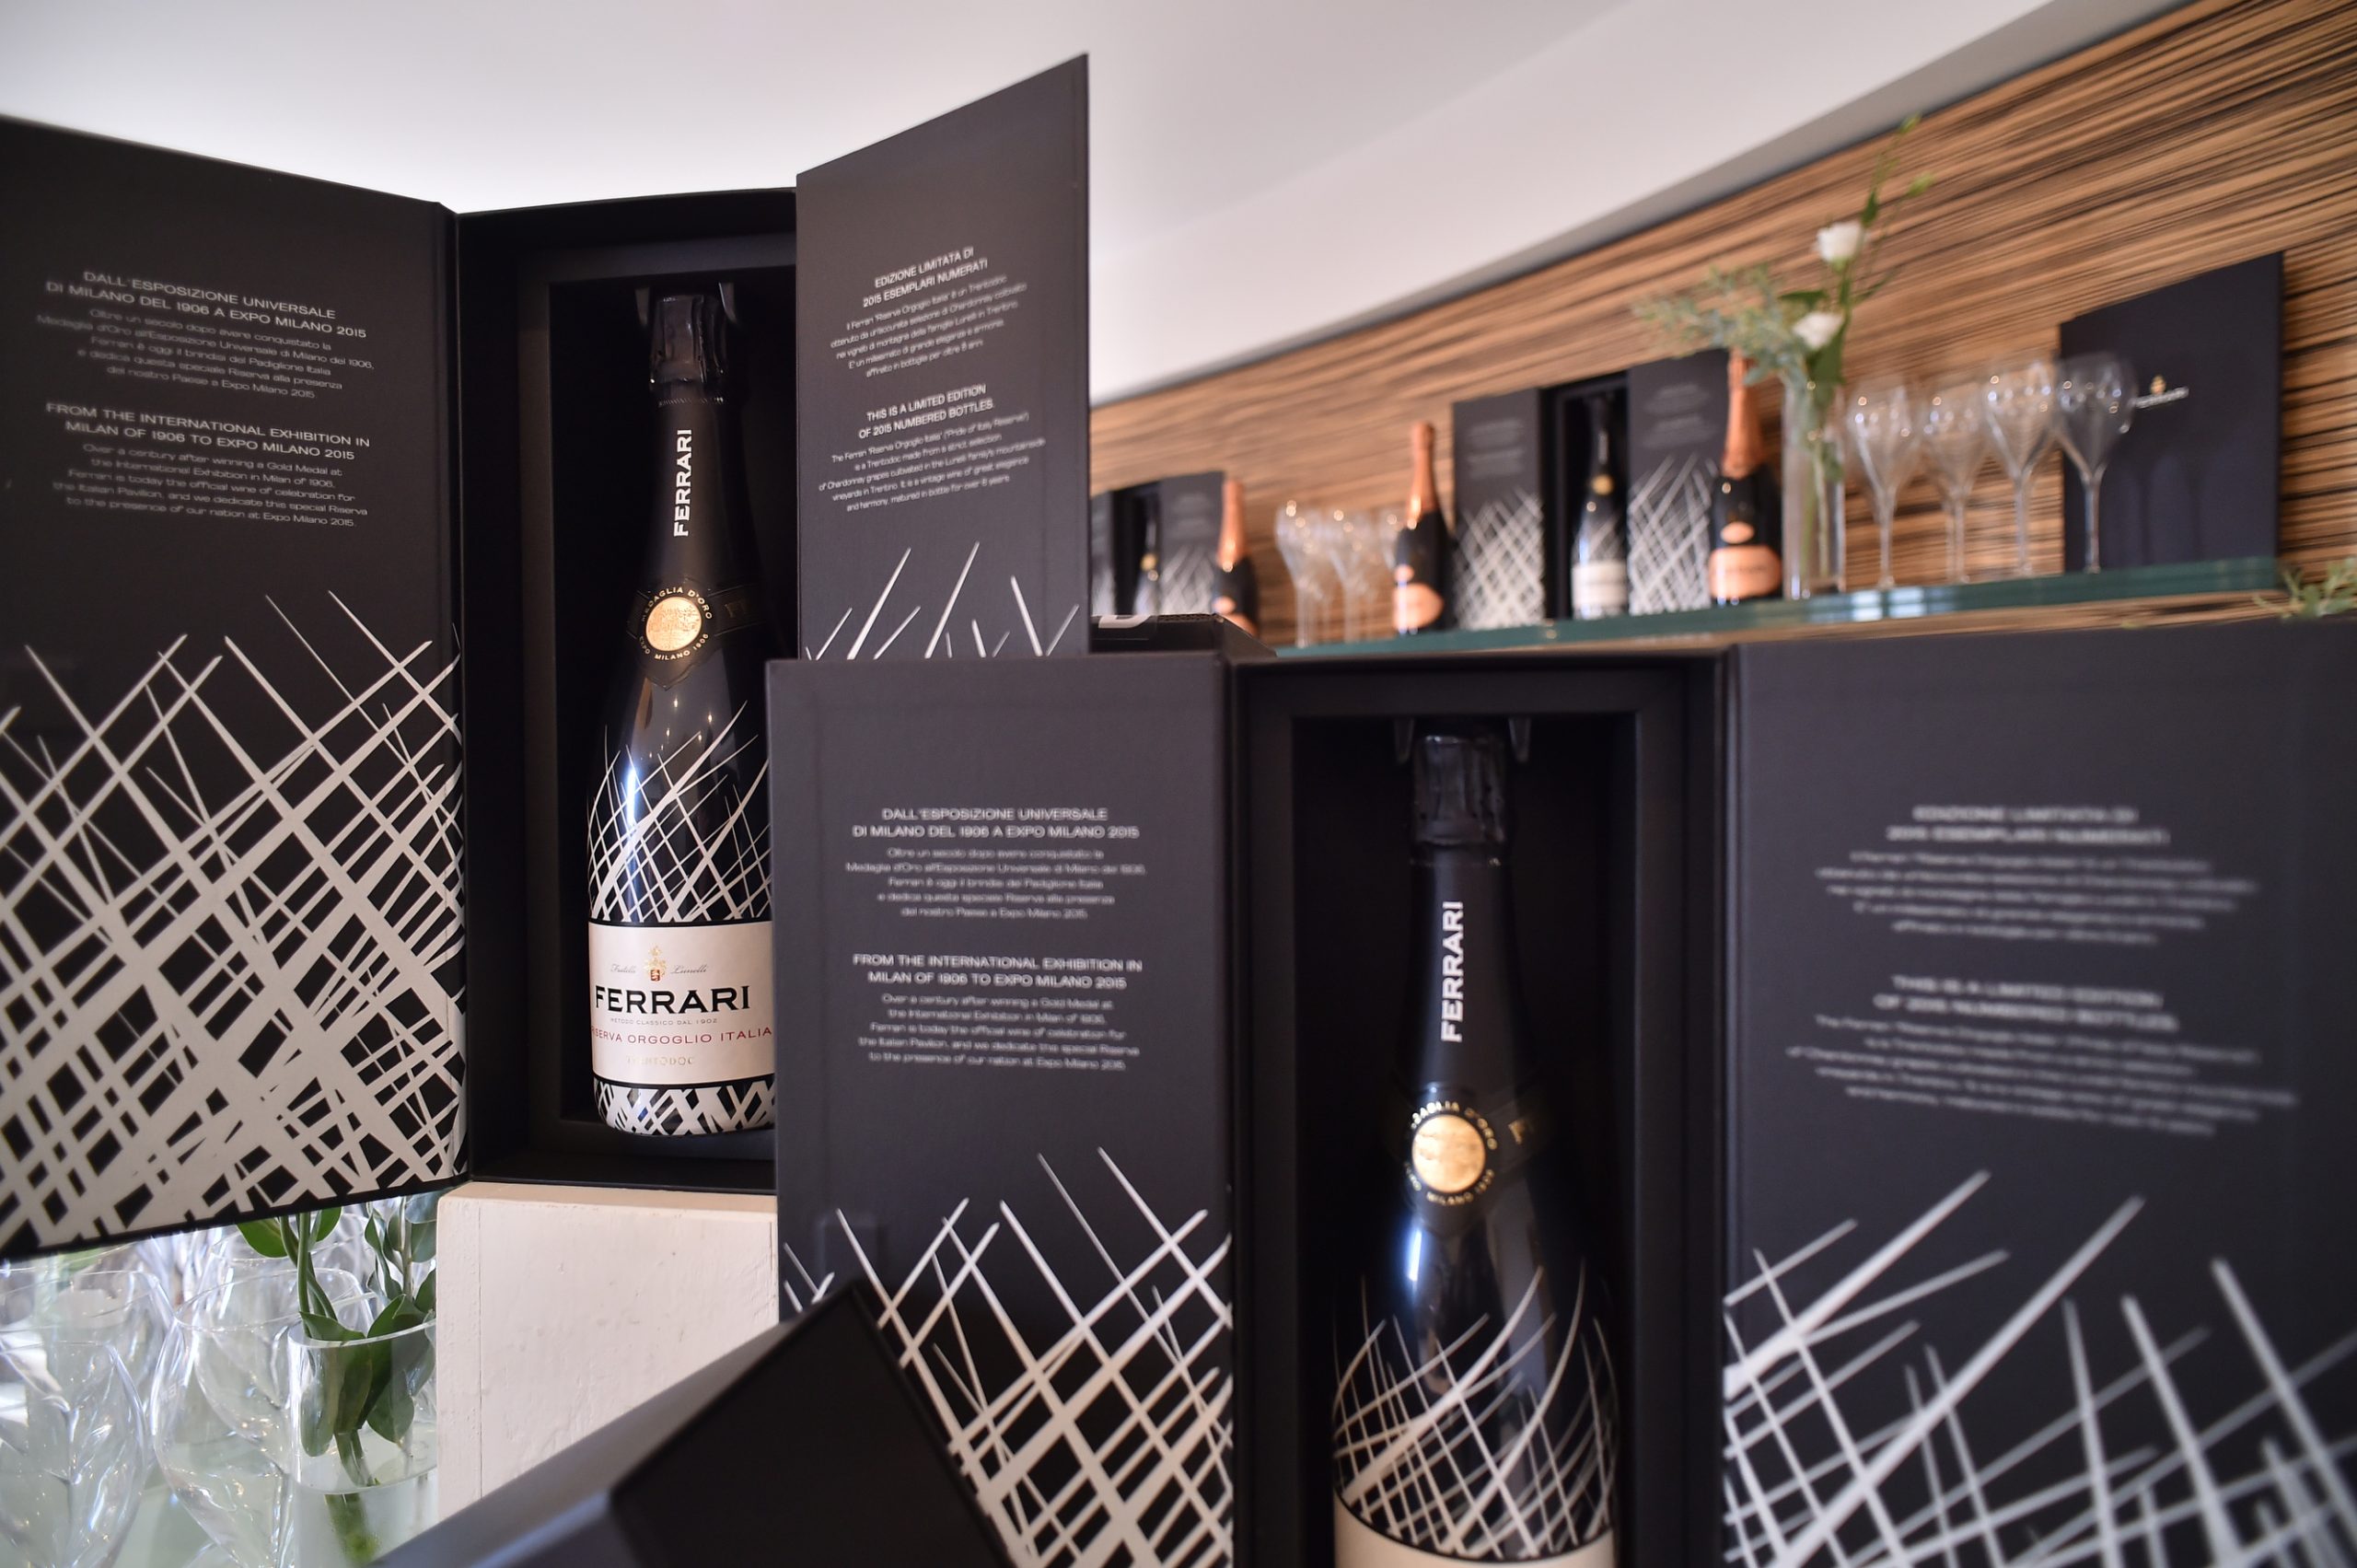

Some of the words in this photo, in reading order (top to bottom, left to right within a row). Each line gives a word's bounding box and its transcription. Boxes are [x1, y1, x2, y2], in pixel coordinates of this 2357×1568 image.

[875, 266, 916, 287] EDIZIONE
[918, 251, 961, 273] LIMITATA
[962, 247, 973, 259] DI
[863, 294, 881, 307] 2015
[883, 276, 935, 300] ESEMPLARI
[936, 259, 987, 283] NUMERATI
[84, 272, 238, 303] DALL'ESPOSIZIONE
[243, 297, 335, 319] UNIVERSALE
[45, 281, 63, 293] DI
[68, 285, 134, 303] MILANO
[139, 296, 170, 308] DEL
[177, 302, 209, 314] 1906
[214, 308, 225, 317] A
[229, 309, 271, 323] EXPO
[274, 317, 331, 332] MILANO
[336, 326, 366, 337] 2015
[219, 329, 251, 339] avere
[253, 334, 319, 348] conquistato
[219, 341, 277, 355] Universale
[293, 351, 327, 362] Milano
[348, 359, 374, 368] 1906,
[228, 367, 270, 379] Riserva
[293, 377, 342, 389] presenza
[306, 366, 331, 375] Italia
[221, 379, 250, 389] Expo
[251, 383, 287, 394] Milano
[866, 408, 887, 421] THIS
[888, 405, 898, 416] IS
[900, 403, 906, 413] A
[908, 394, 945, 412] LIMITED
[946, 384, 986, 401] EDITION
[46, 402, 97, 416] FROM
[102, 409, 134, 422] THE
[140, 414, 265, 436] INTERNATIONAL
[270, 428, 351, 444] EXHIBITION
[355, 437, 369, 447] IN
[858, 427, 871, 438] OF
[873, 423, 891, 436] 2015
[893, 410, 946, 429] NUMBERED
[65, 421, 119, 435] MILAN
[123, 427, 146, 437] OF
[152, 431, 185, 442] 1906
[190, 434, 212, 445] TO
[216, 437, 258, 449] EXPO
[262, 442, 319, 456] MILANO
[325, 449, 354, 459] 2015
[206, 458, 254, 469] winning
[266, 462, 293, 470] Gold
[296, 464, 328, 474] Medal
[262, 474, 291, 482] Milan
[308, 479, 334, 487] 1906.
[674, 429, 691, 537] FERRARI
[274, 490, 335, 499] celebration
[213, 496, 262, 506] dedicate
[265, 500, 286, 508] this
[328, 505, 367, 515] Riserva
[262, 512, 290, 521] Expo
[293, 515, 328, 524] Milano
[688, 589, 712, 620] D'ORO
[655, 650, 691, 660] MILANO
[1017, 808, 1107, 820] UNIVERSALE
[853, 825, 867, 837] DI
[870, 826, 924, 837] MILANO
[927, 826, 956, 837] DEL
[992, 826, 1003, 836] A
[1005, 826, 1045, 838] EXPO
[1048, 826, 1105, 838] MILANO
[1108, 826, 1139, 838] 2015
[853, 954, 894, 965] FROM
[897, 955, 924, 967] THE
[928, 956, 1039, 969] INTERNATIONAL
[1042, 958, 1123, 970] EXHIBITION
[1126, 959, 1142, 971] IN
[1441, 901, 1463, 1042] FERRARI
[867, 971, 911, 982] MILAN
[914, 972, 934, 983] OF
[970, 973, 991, 985] TO
[993, 974, 1033, 986] EXPO
[1035, 975, 1092, 988] MILANO
[1095, 977, 1127, 989] 2015
[596, 985, 750, 1014] FERRARI
[628, 1034, 713, 1044] ORGOGLIO
[721, 1027, 772, 1041] ITALIA
